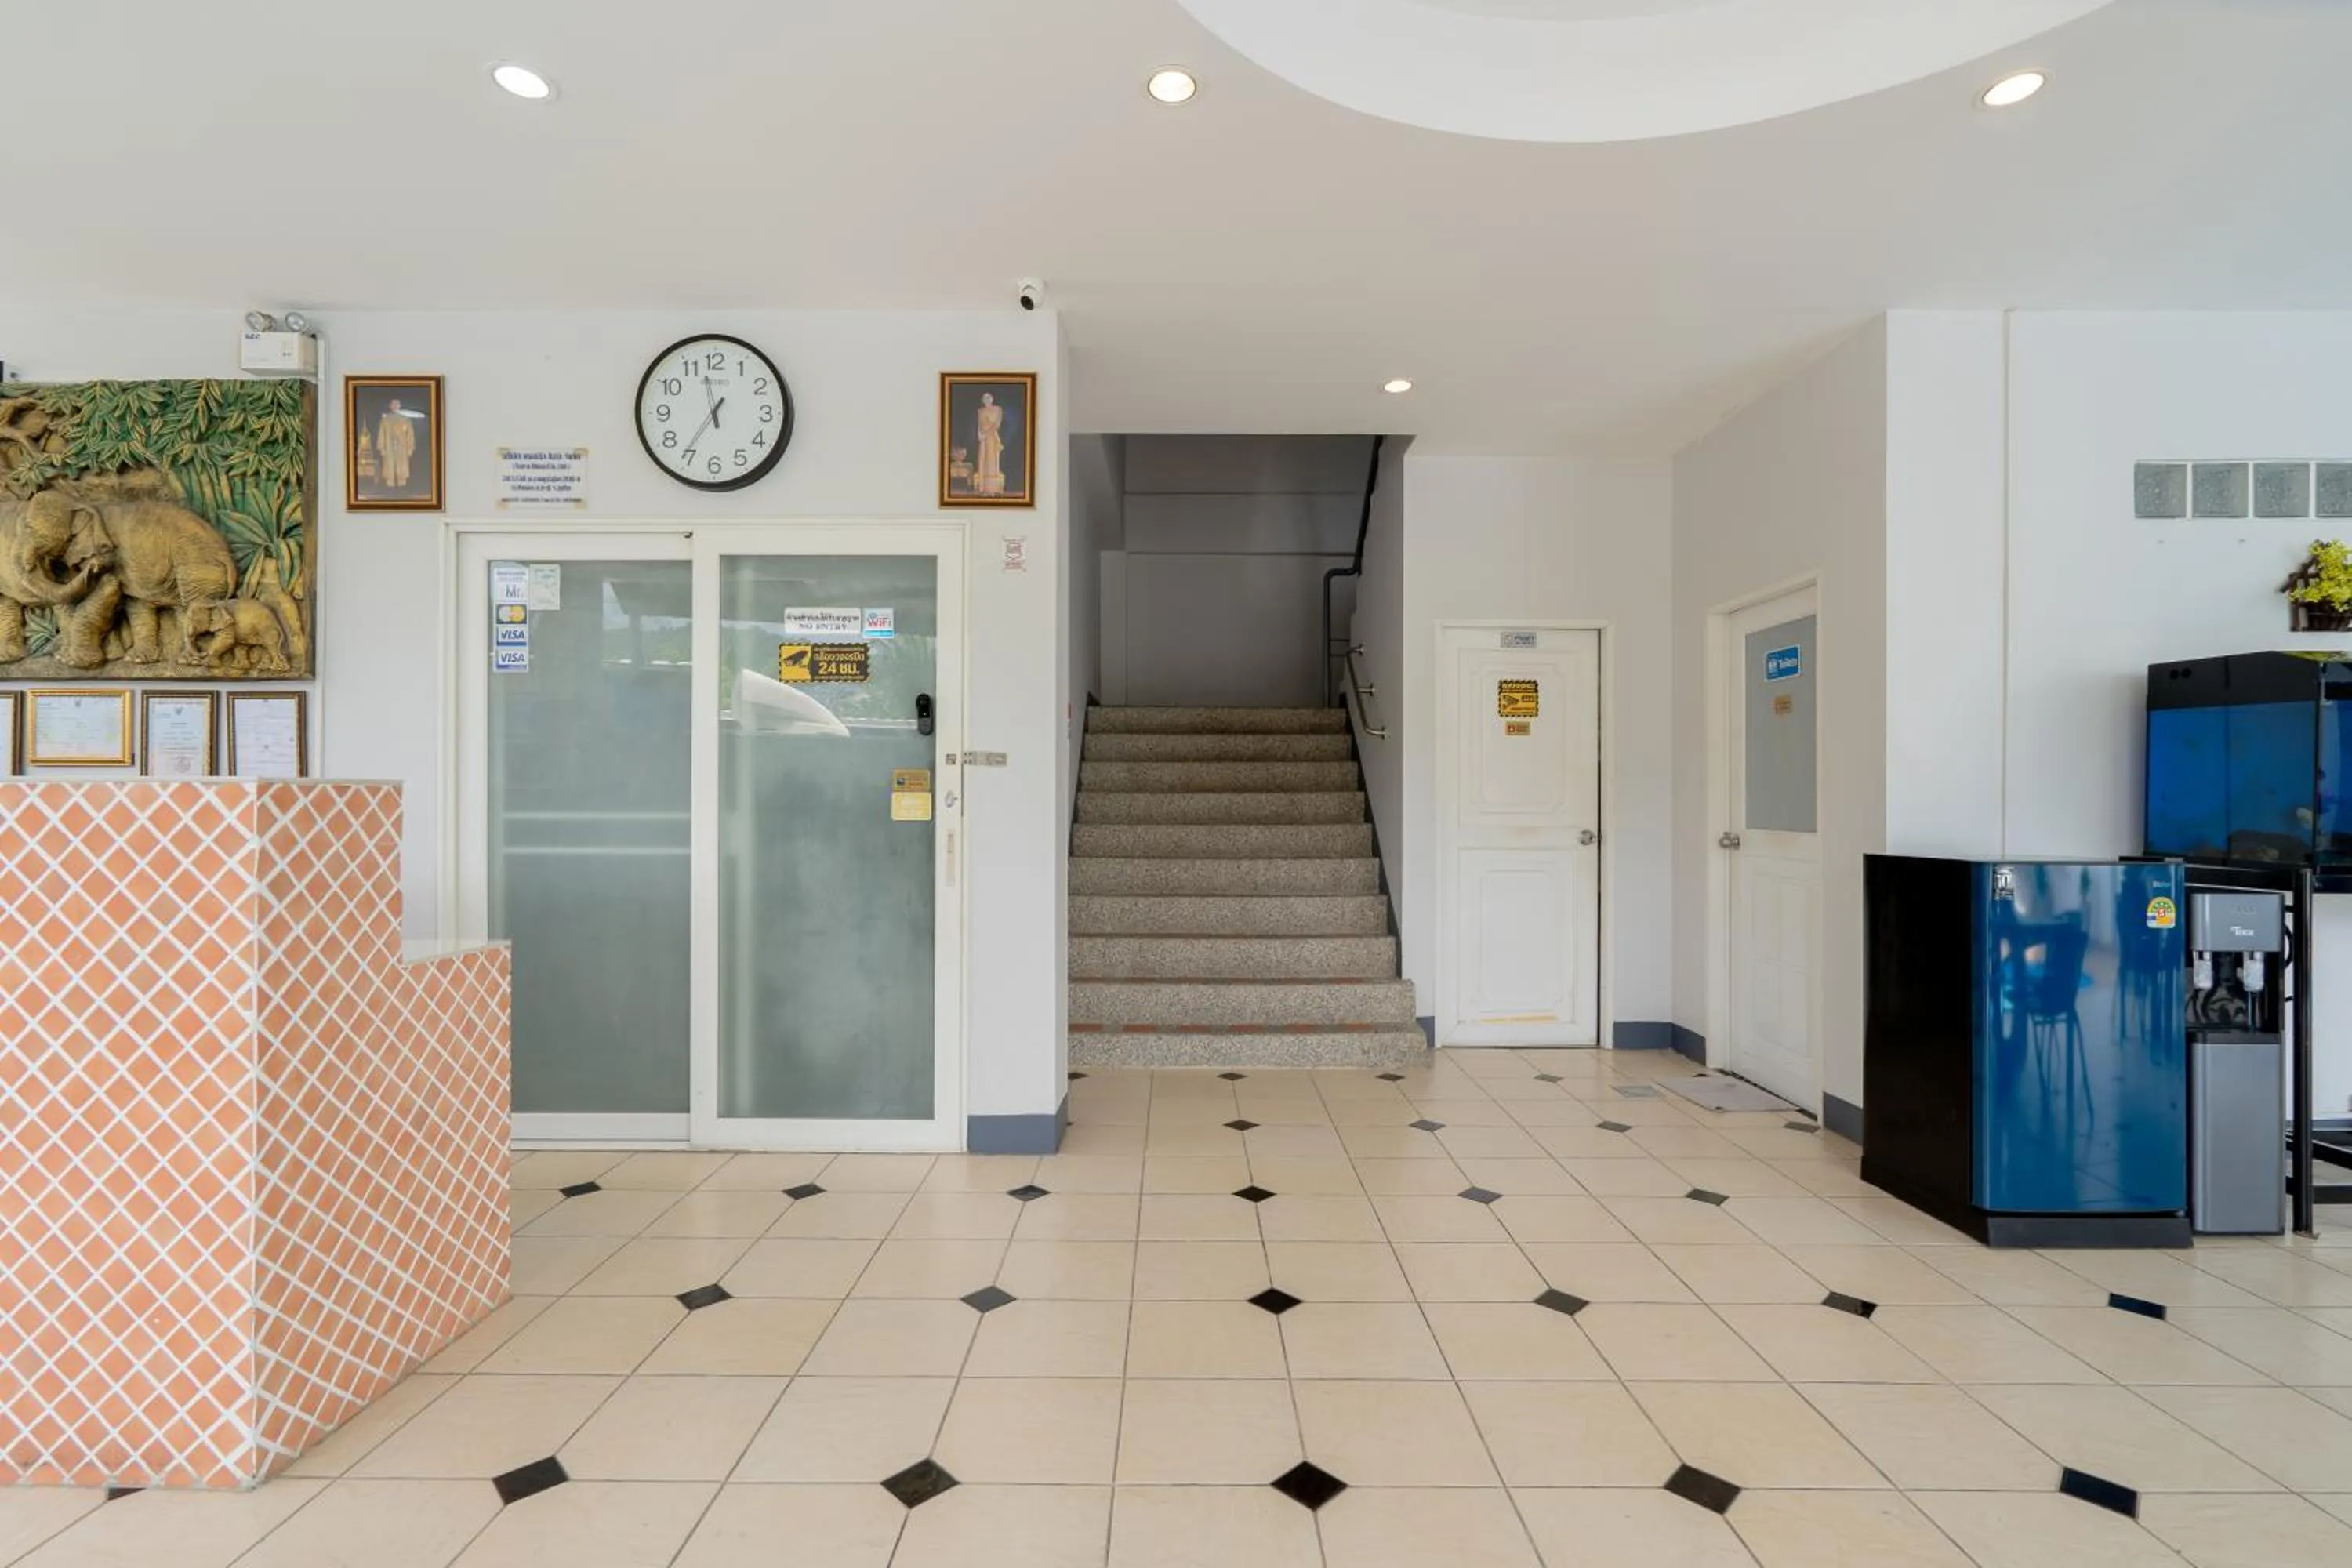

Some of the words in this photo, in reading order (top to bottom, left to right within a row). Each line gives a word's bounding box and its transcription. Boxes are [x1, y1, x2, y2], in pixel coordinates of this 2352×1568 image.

[683, 361, 699, 377] 11
[706, 353, 725, 371] 12
[737, 361, 744, 377] 1
[662, 378, 681, 396] 10
[753, 378, 768, 396] 2
[656, 404, 670, 423] 9
[760, 404, 773, 423] 3
[662, 430, 677, 448] 8
[752, 431, 766, 448] 4
[684, 449, 697, 466] 7
[708, 456, 722, 474] 6
[734, 449, 747, 466] 5
[502, 630, 524, 640] VISA
[501, 653, 525, 662] VISA
[818, 662, 837, 675] 24
